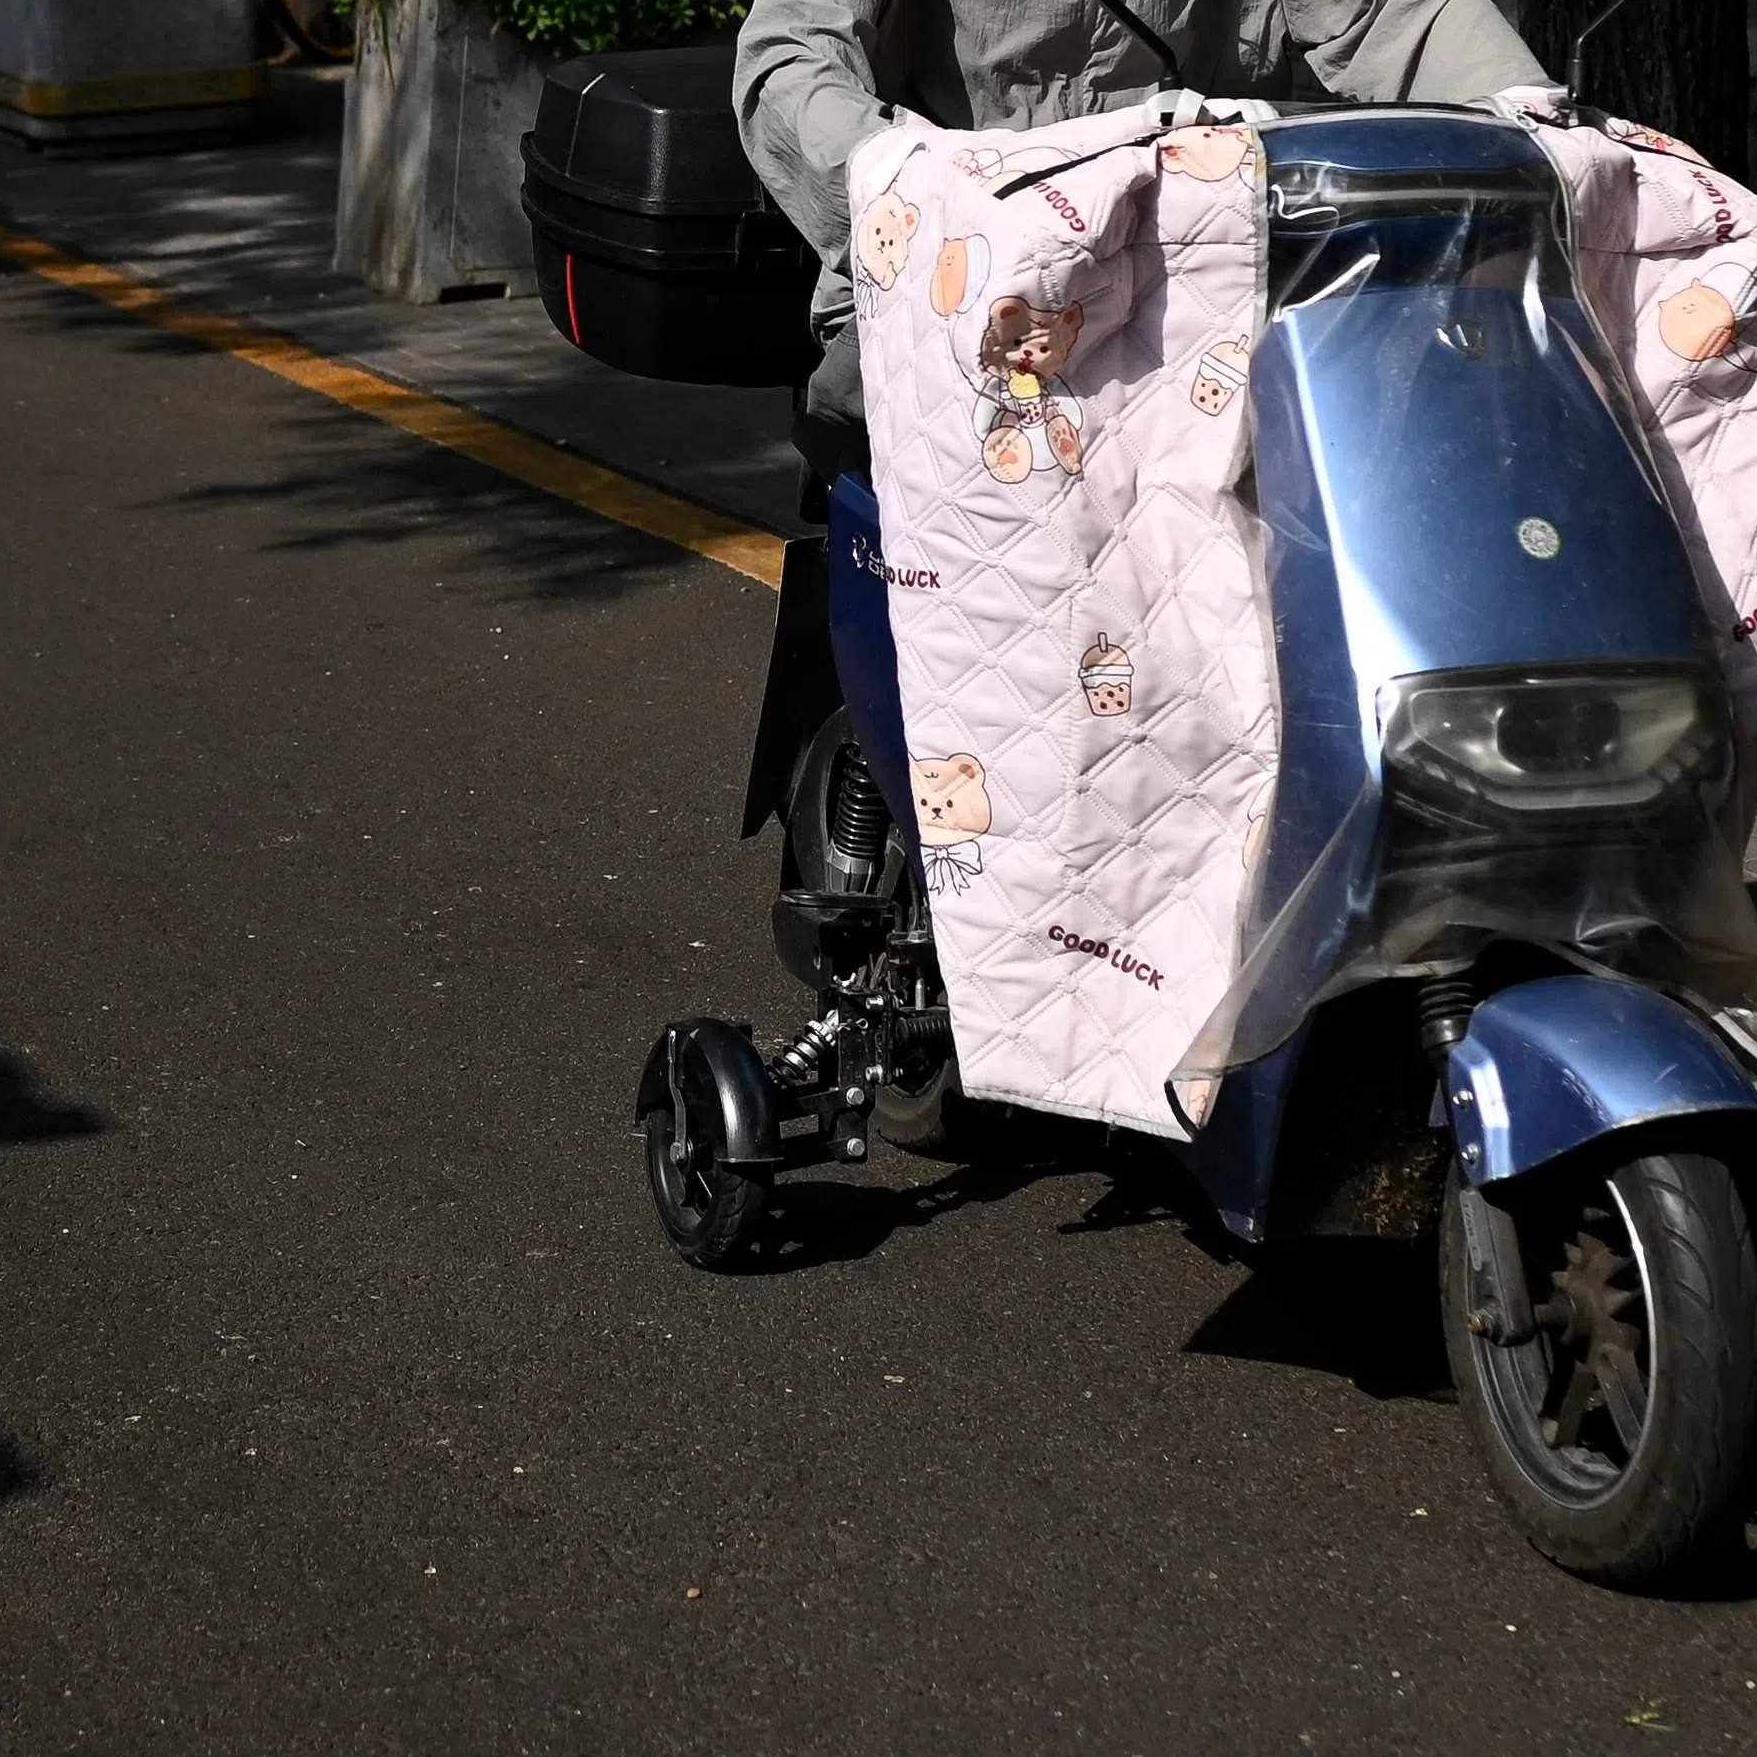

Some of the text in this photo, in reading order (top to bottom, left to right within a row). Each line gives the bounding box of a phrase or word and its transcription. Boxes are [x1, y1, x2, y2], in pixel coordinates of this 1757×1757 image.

[1688, 170, 1727, 204] LUCK
[1045, 190, 1086, 232] GOOD
[898, 568, 941, 589] LUCK
[1048, 925, 1165, 991] GOOD LUCK
